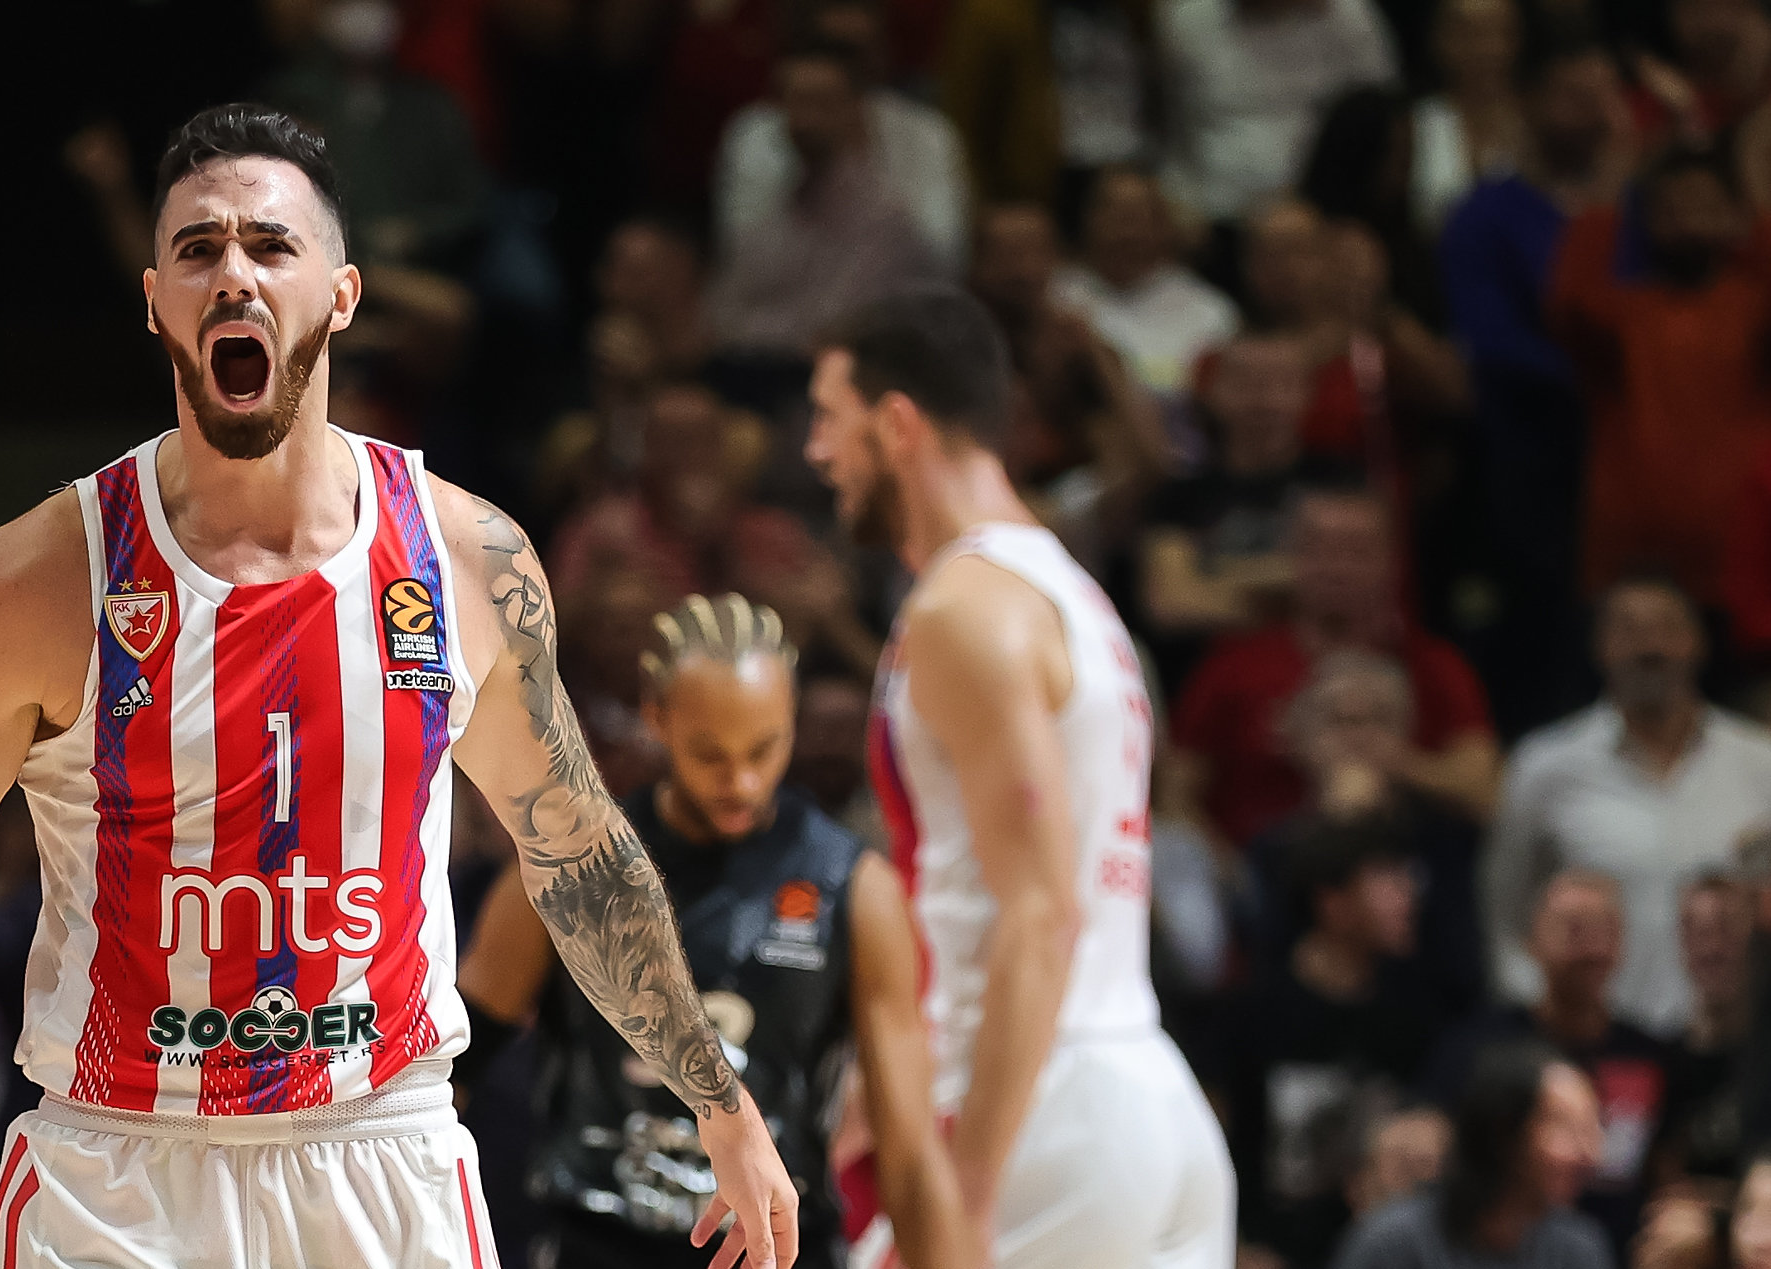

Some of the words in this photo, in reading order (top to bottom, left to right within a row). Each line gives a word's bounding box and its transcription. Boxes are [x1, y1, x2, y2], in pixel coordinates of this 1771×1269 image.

[114, 603, 130, 613] KK
[392, 634, 436, 645] TURKISH
[393, 643, 437, 654] AIRLINES
[267, 712, 292, 823] 1
[159, 856, 384, 952] mts
[148, 1000, 384, 1052] SOCCER
